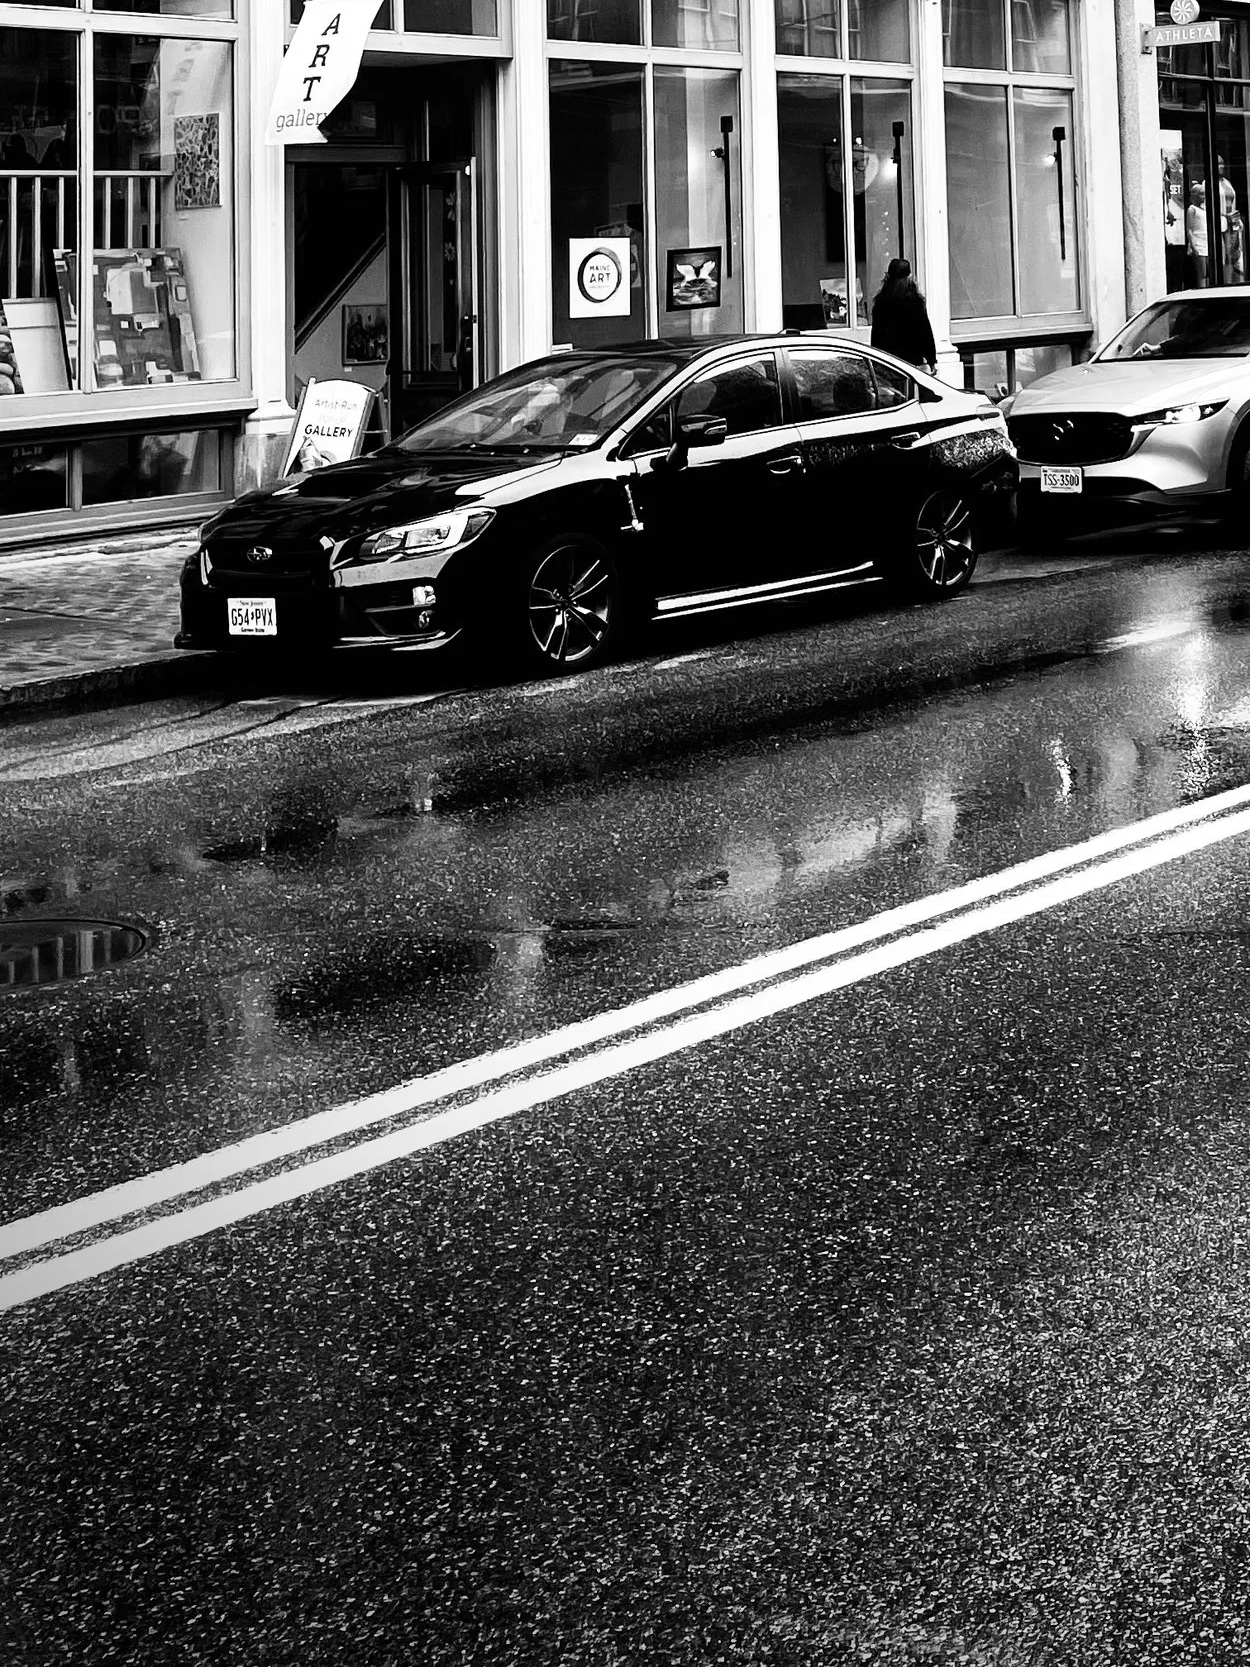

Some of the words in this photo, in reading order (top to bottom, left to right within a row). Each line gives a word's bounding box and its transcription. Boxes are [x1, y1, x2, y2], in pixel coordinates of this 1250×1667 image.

[1156, 26, 1213, 43] ATHLETA
[303, 13, 341, 102] ART
[589, 273, 611, 283] ART
[304, 424, 353, 438] GALLERY
